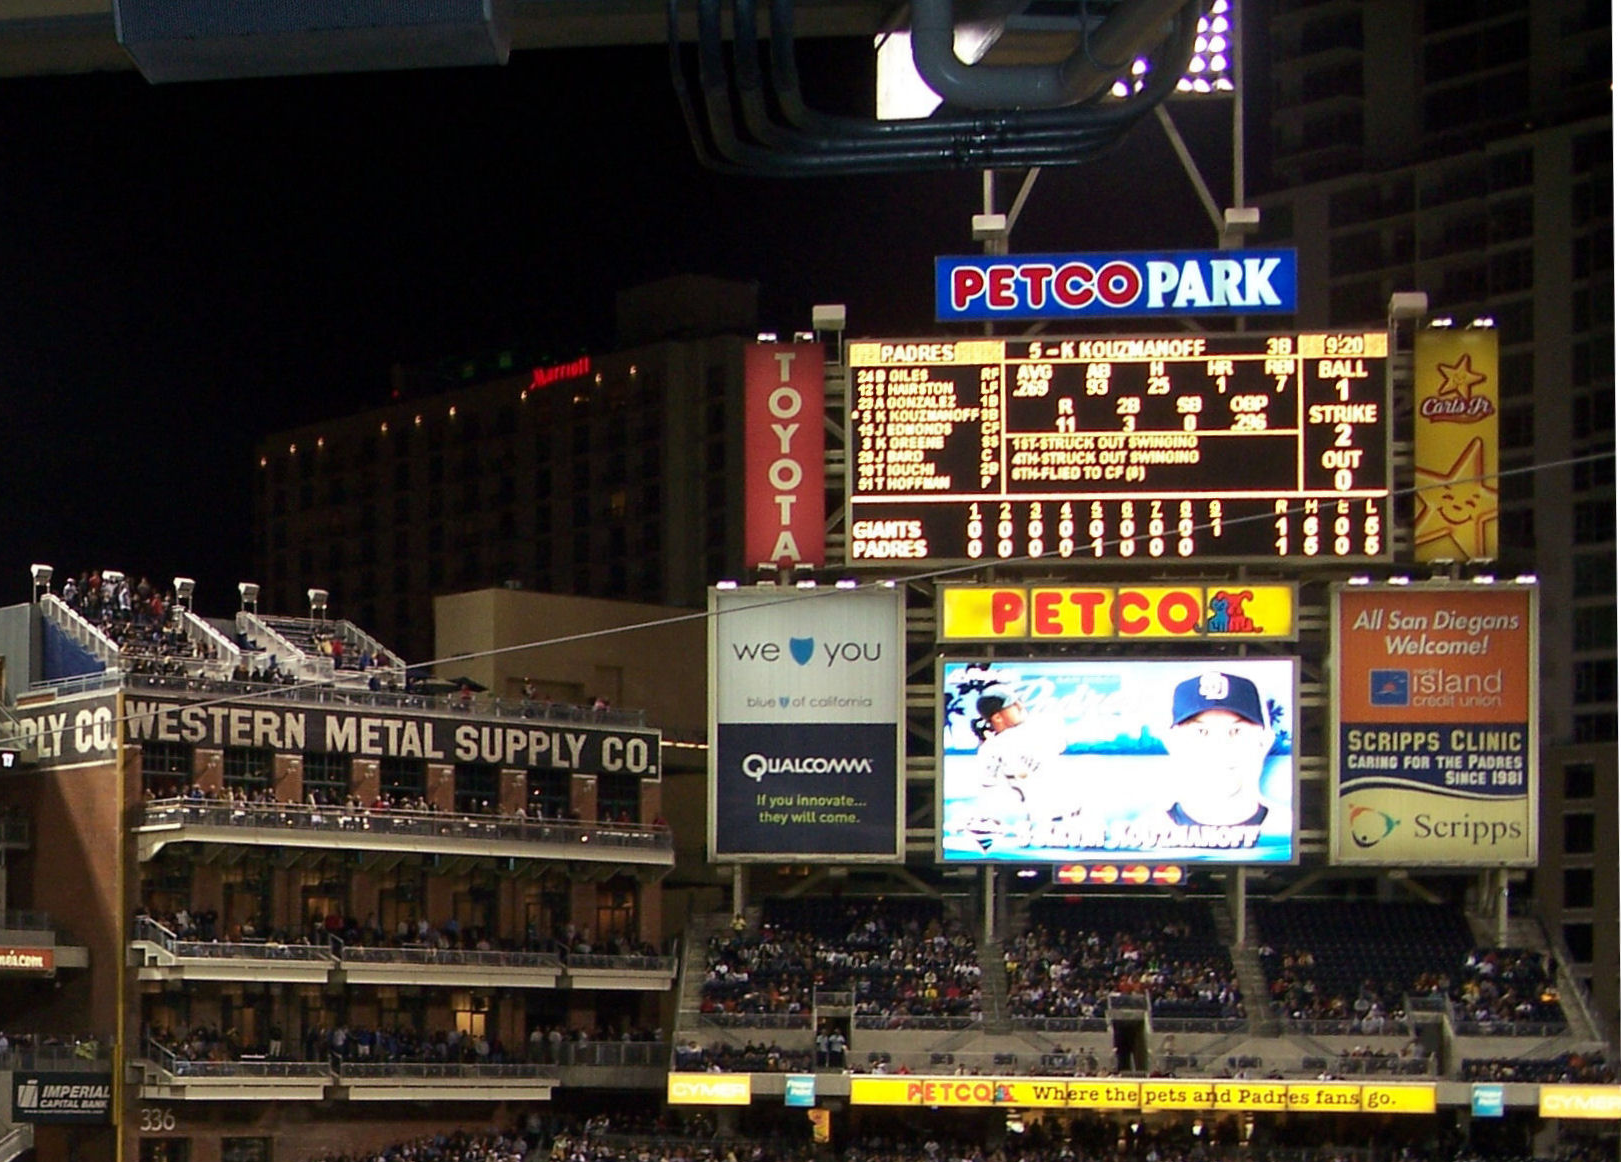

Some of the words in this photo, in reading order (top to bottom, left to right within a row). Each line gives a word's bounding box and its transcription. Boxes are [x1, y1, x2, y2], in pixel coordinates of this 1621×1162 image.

[951, 261, 1142, 312] PETCO
[1147, 258, 1282, 308] PARK
[882, 344, 955, 362] PADRES
[1028, 342, 1042, 360] 5
[1061, 341, 1075, 359] K
[1079, 338, 1206, 359] KOUZMANOFF
[1266, 337, 1293, 355] 3B
[529, 356, 592, 390] Marriott
[1016, 363, 1054, 380] AVG
[1318, 359, 1369, 379] BALL
[1085, 378, 1110, 396] 93
[1147, 376, 1170, 395] 25
[1215, 375, 1227, 394] 1
[1275, 375, 1288, 393] 7
[1334, 378, 1350, 402] 1
[1057, 397, 1074, 415] R
[1116, 397, 1141, 415] 2B
[1308, 404, 1377, 424] STRIKE
[1054, 415, 1076, 433] 11
[1122, 415, 1135, 433] 3
[1183, 413, 1197, 432] 0
[1334, 424, 1353, 448] 2
[768, 352, 803, 561] TOYOTA
[1321, 450, 1363, 468] OUT
[1334, 468, 1353, 492] 0
[852, 520, 923, 540] GIANTS
[852, 540, 928, 559] PADRES
[991, 590, 1202, 635] PETCO
[1352, 609, 1383, 631] All
[1388, 610, 1428, 631] San
[1433, 609, 1520, 636] Diegans
[732, 641, 781, 663] we
[824, 641, 882, 668] you
[1385, 634, 1490, 656] Welcome!
[1412, 667, 1503, 694] island
[746, 696, 776, 709] blue
[791, 696, 806, 709] of
[809, 695, 874, 709] california
[1412, 694, 1455, 707] credit
[1459, 694, 1503, 708] union
[124, 699, 308, 751] WESTERN
[325, 715, 445, 761] METAL
[454, 723, 586, 770] SUPPLY
[601, 736, 658, 775] CO.
[1347, 730, 1441, 752] SCRIPPS
[1450, 729, 1523, 752] CLINIC
[742, 753, 874, 782] QUALCOMM
[1347, 754, 1399, 770] CARING
[1403, 754, 1431, 770] FOR
[1435, 755, 1464, 770] THE
[1467, 754, 1524, 770] PADRES
[1444, 770, 1488, 786] SINCE
[1491, 770, 1524, 786] 1981
[756, 794, 767, 807] If
[769, 797, 794, 810] you
[759, 811, 789, 825] they
[791, 811, 816, 824] will
[819, 812, 861, 824] come.
[1414, 813, 1523, 846] Scripps
[42, 1084, 111, 1099] IMPERIAL
[673, 1083, 747, 1097] CYMER
[907, 1082, 994, 1102] PETCO
[1032, 1086, 1099, 1101] Where
[1105, 1087, 1139, 1102] the
[1143, 1088, 1186, 1106] pets
[1192, 1088, 1232, 1104] and
[1237, 1088, 1311, 1106] Padres
[1315, 1089, 1361, 1105] fans
[1366, 1091, 1397, 1110] go.
[39, 1099, 80, 1110] CAPITAL
[80, 1100, 109, 1110] BANK
[139, 1108, 176, 1132] 336
